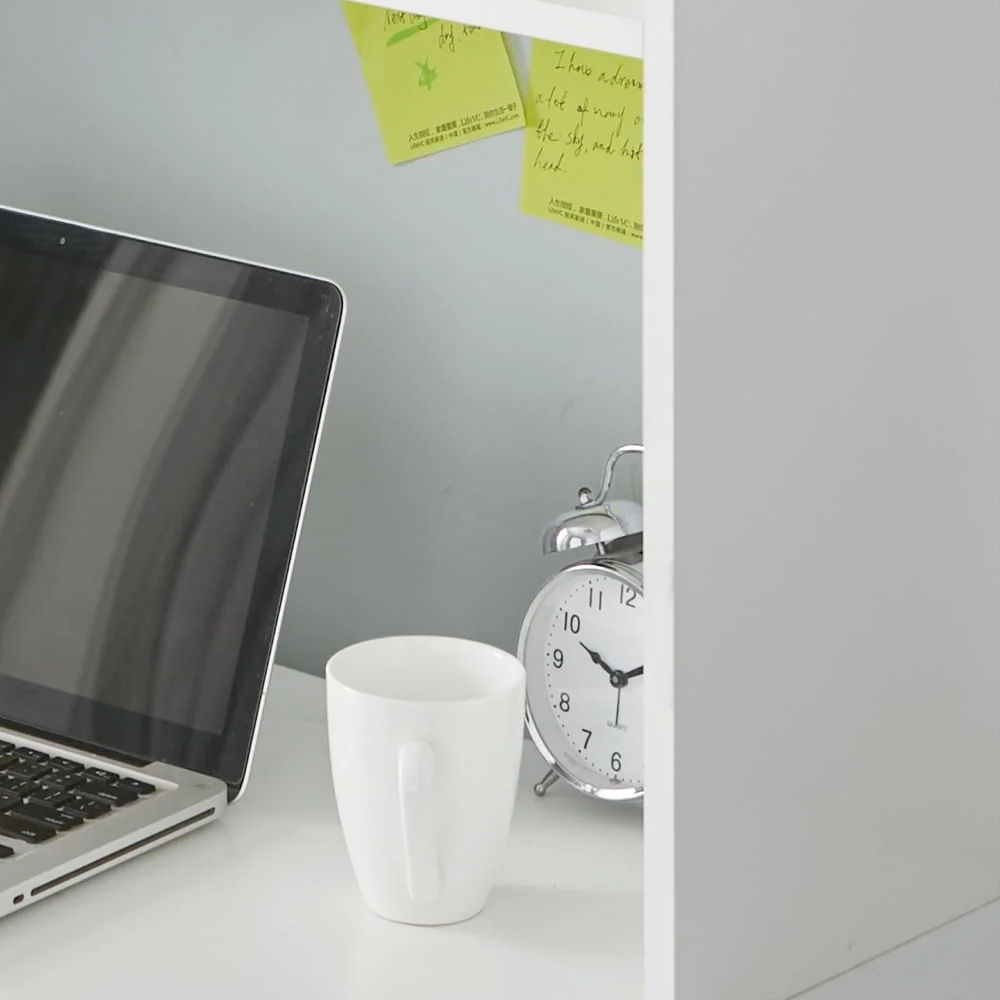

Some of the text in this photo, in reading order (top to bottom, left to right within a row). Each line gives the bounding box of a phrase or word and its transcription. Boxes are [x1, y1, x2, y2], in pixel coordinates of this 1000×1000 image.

[554, 49, 565, 70] I
[588, 587, 603, 611] 11
[619, 584, 637, 608] 12
[563, 611, 581, 634] 10
[552, 648, 564, 669] 9
[559, 692, 570, 713] 8
[581, 728, 593, 750] 7
[610, 751, 622, 773] 6
